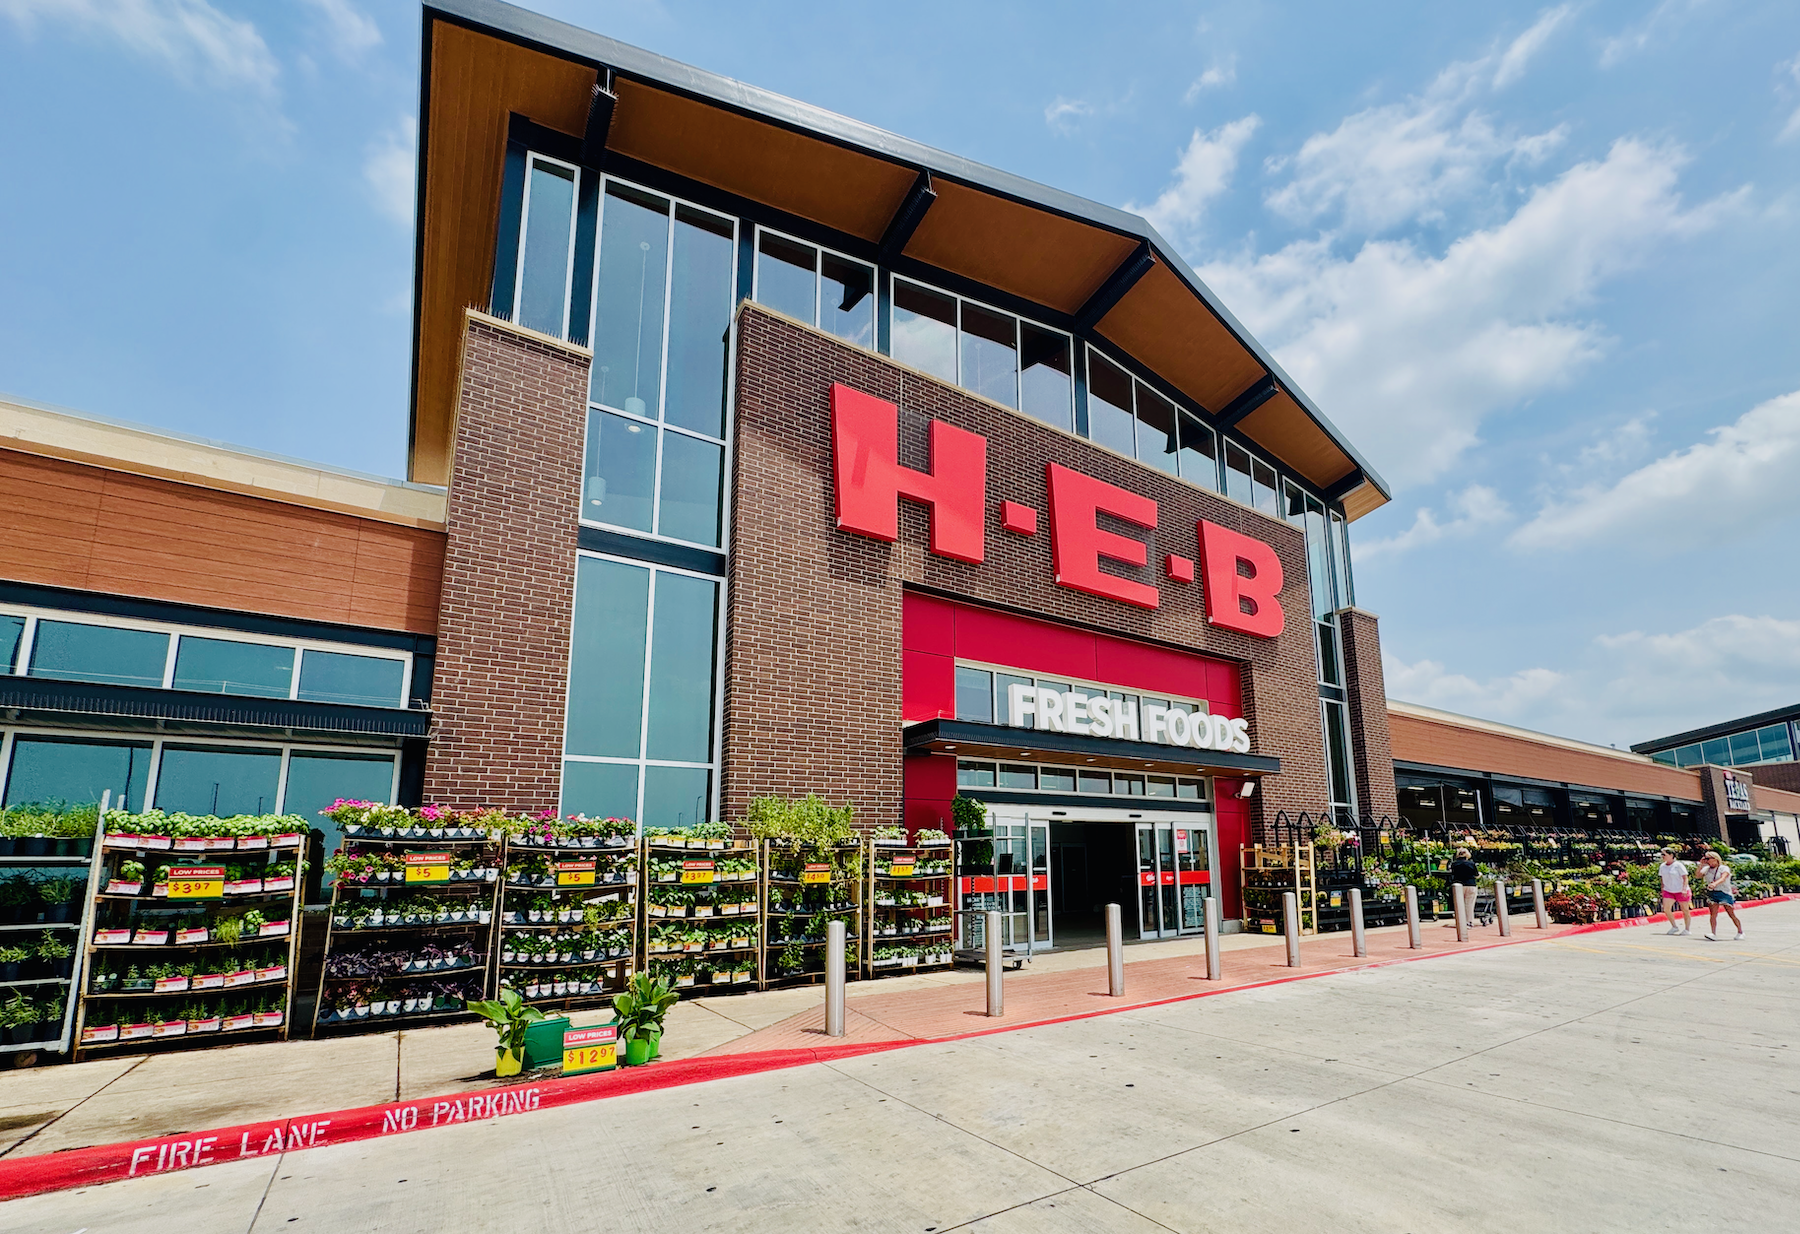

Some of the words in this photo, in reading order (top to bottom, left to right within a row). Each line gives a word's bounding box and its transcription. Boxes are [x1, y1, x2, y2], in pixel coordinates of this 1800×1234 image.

[1008, 683, 1141, 741] FRESH
[1143, 704, 1251, 754] FOODS
[416, 867, 431, 878] $5
[568, 1032, 587, 1041] LOW
[587, 1030, 613, 1039] PRICES
[128, 1136, 218, 1177] FIRE
[239, 1119, 332, 1157] LANE
[382, 1106, 418, 1133] NO
[432, 1088, 541, 1126] PARKING
